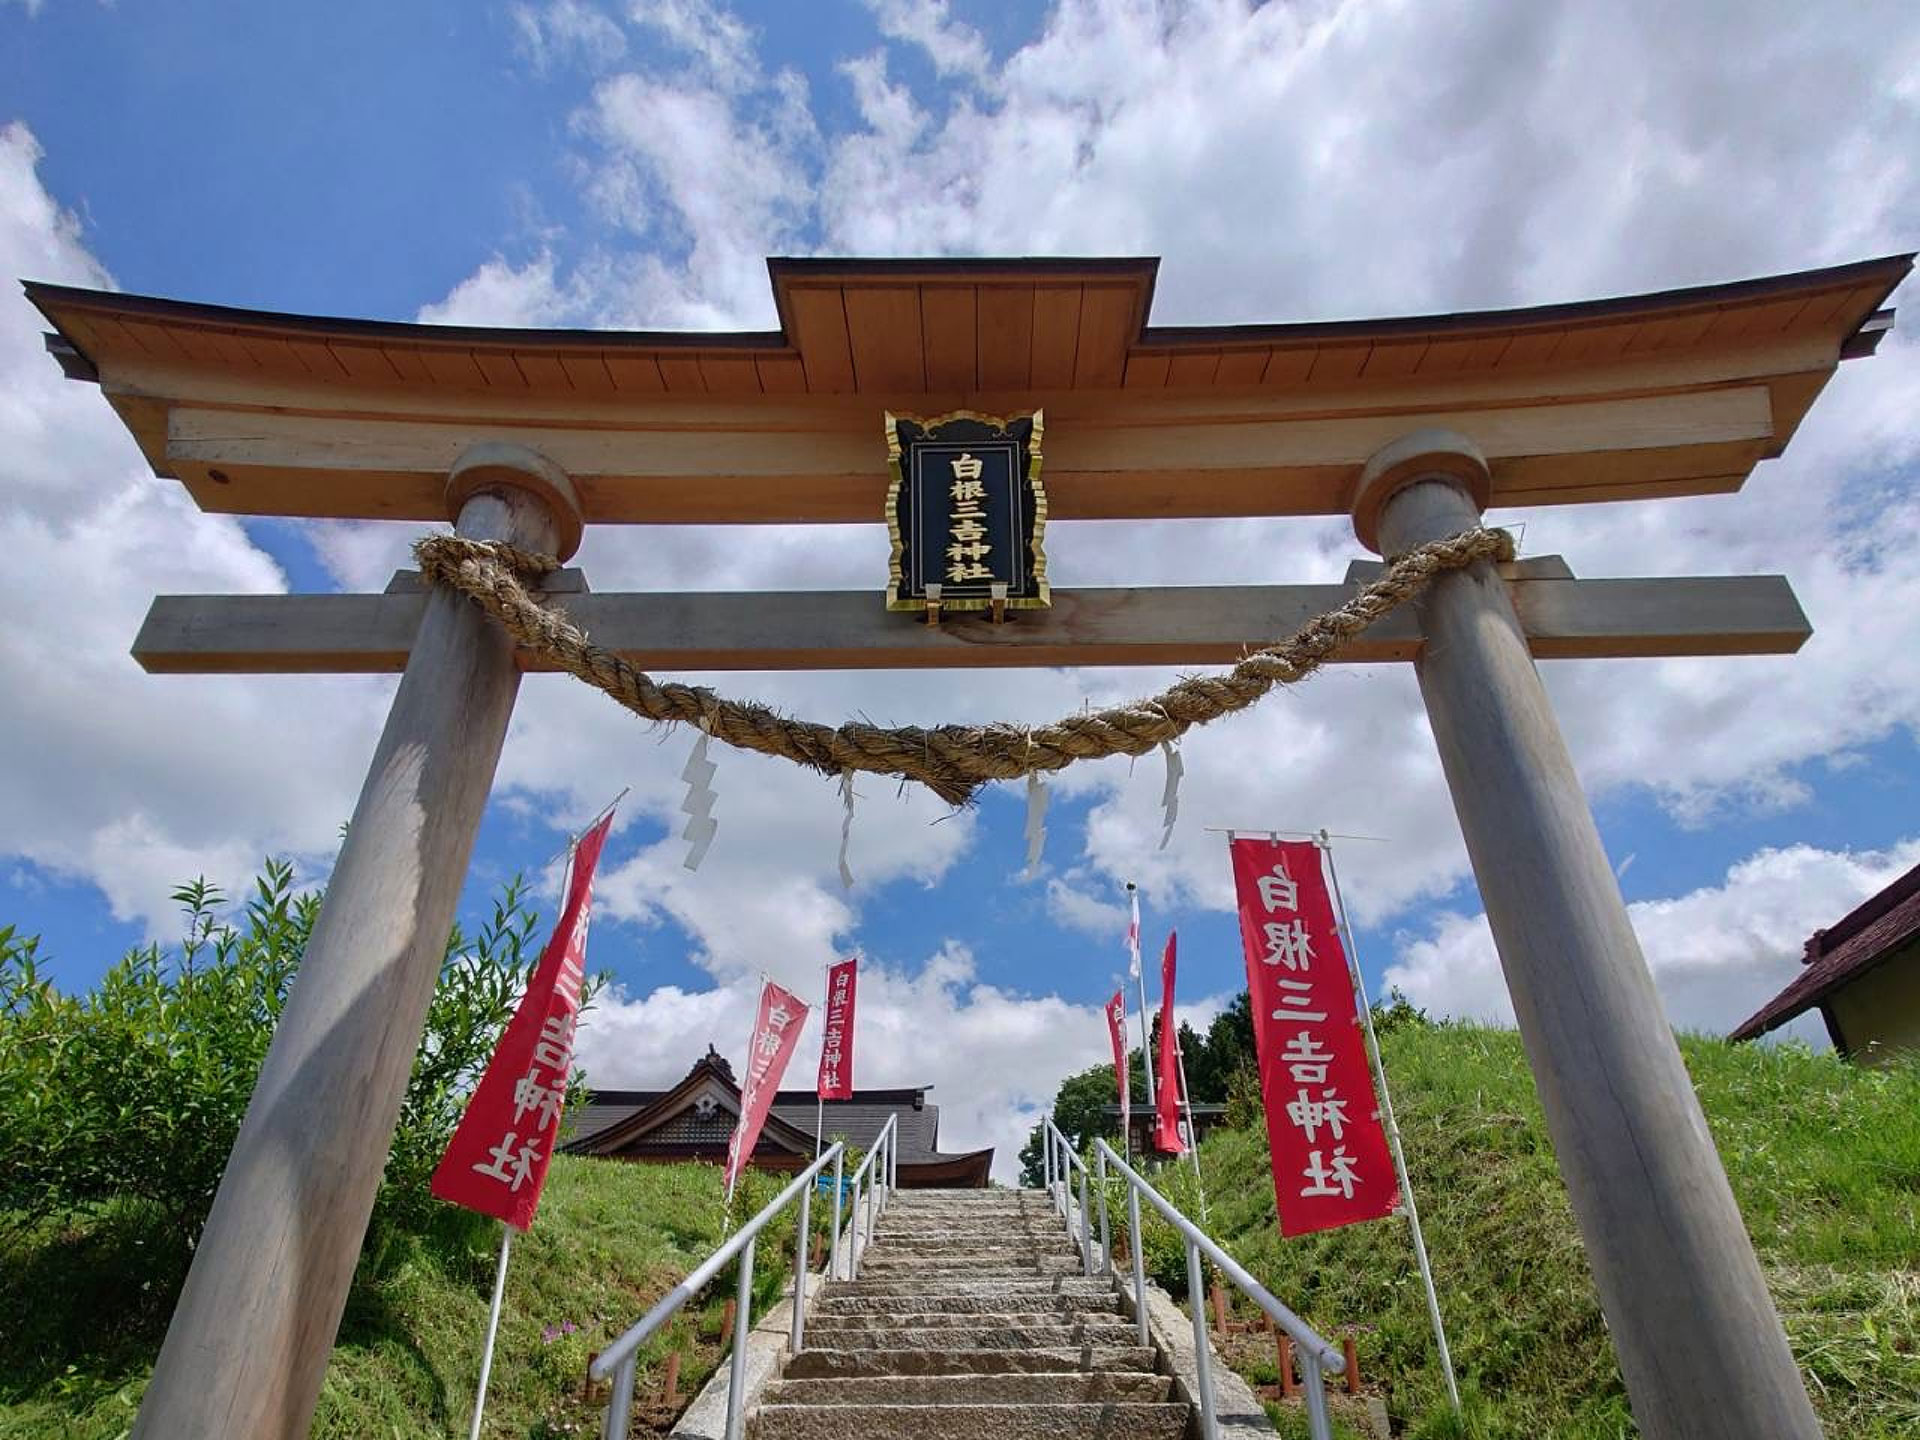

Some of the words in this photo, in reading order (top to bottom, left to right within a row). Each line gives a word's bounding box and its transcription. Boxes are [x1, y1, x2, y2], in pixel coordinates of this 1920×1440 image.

[946, 452, 995, 583] 白根三吉神社
